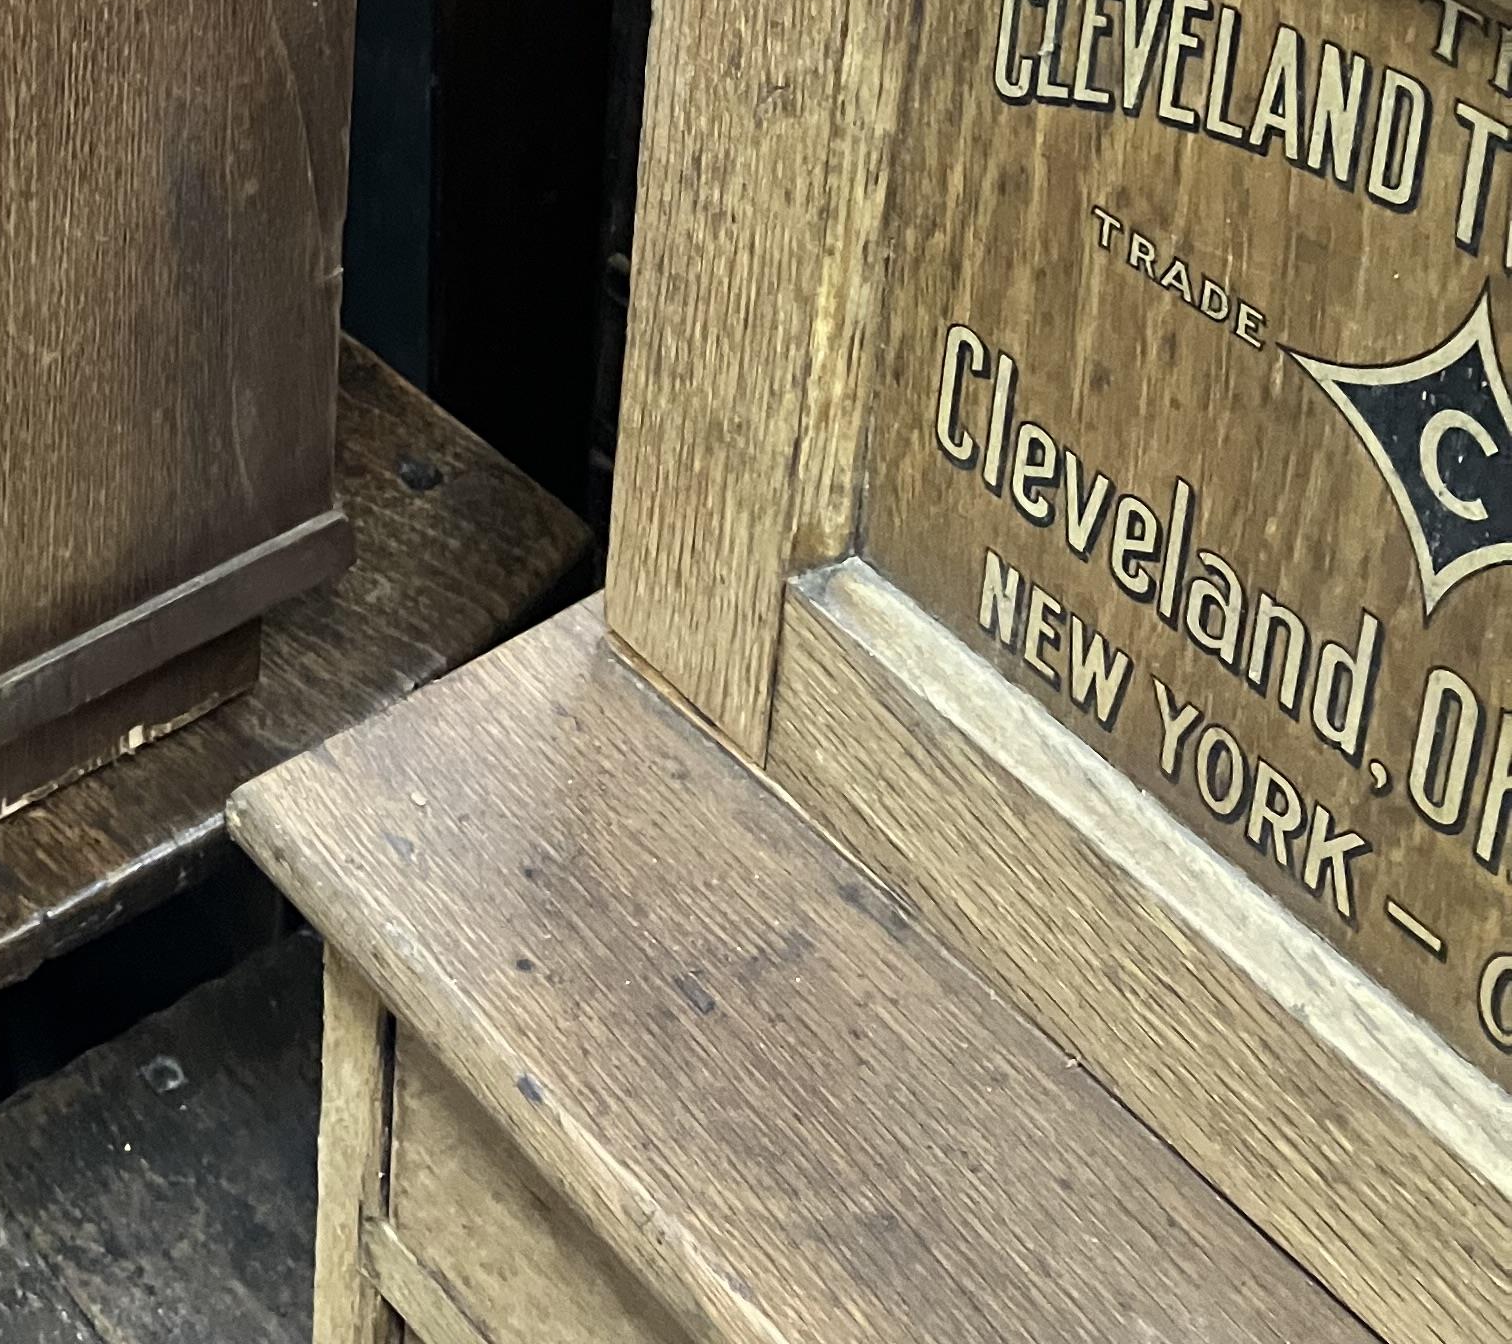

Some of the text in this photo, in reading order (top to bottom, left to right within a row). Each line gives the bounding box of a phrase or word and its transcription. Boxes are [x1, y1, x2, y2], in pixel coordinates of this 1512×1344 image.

[1091, 206, 1270, 349] TRADE
[1419, 408, 1500, 521] C
[978, 550, 1134, 731] NEW
[1150, 673, 1374, 920] YORK
